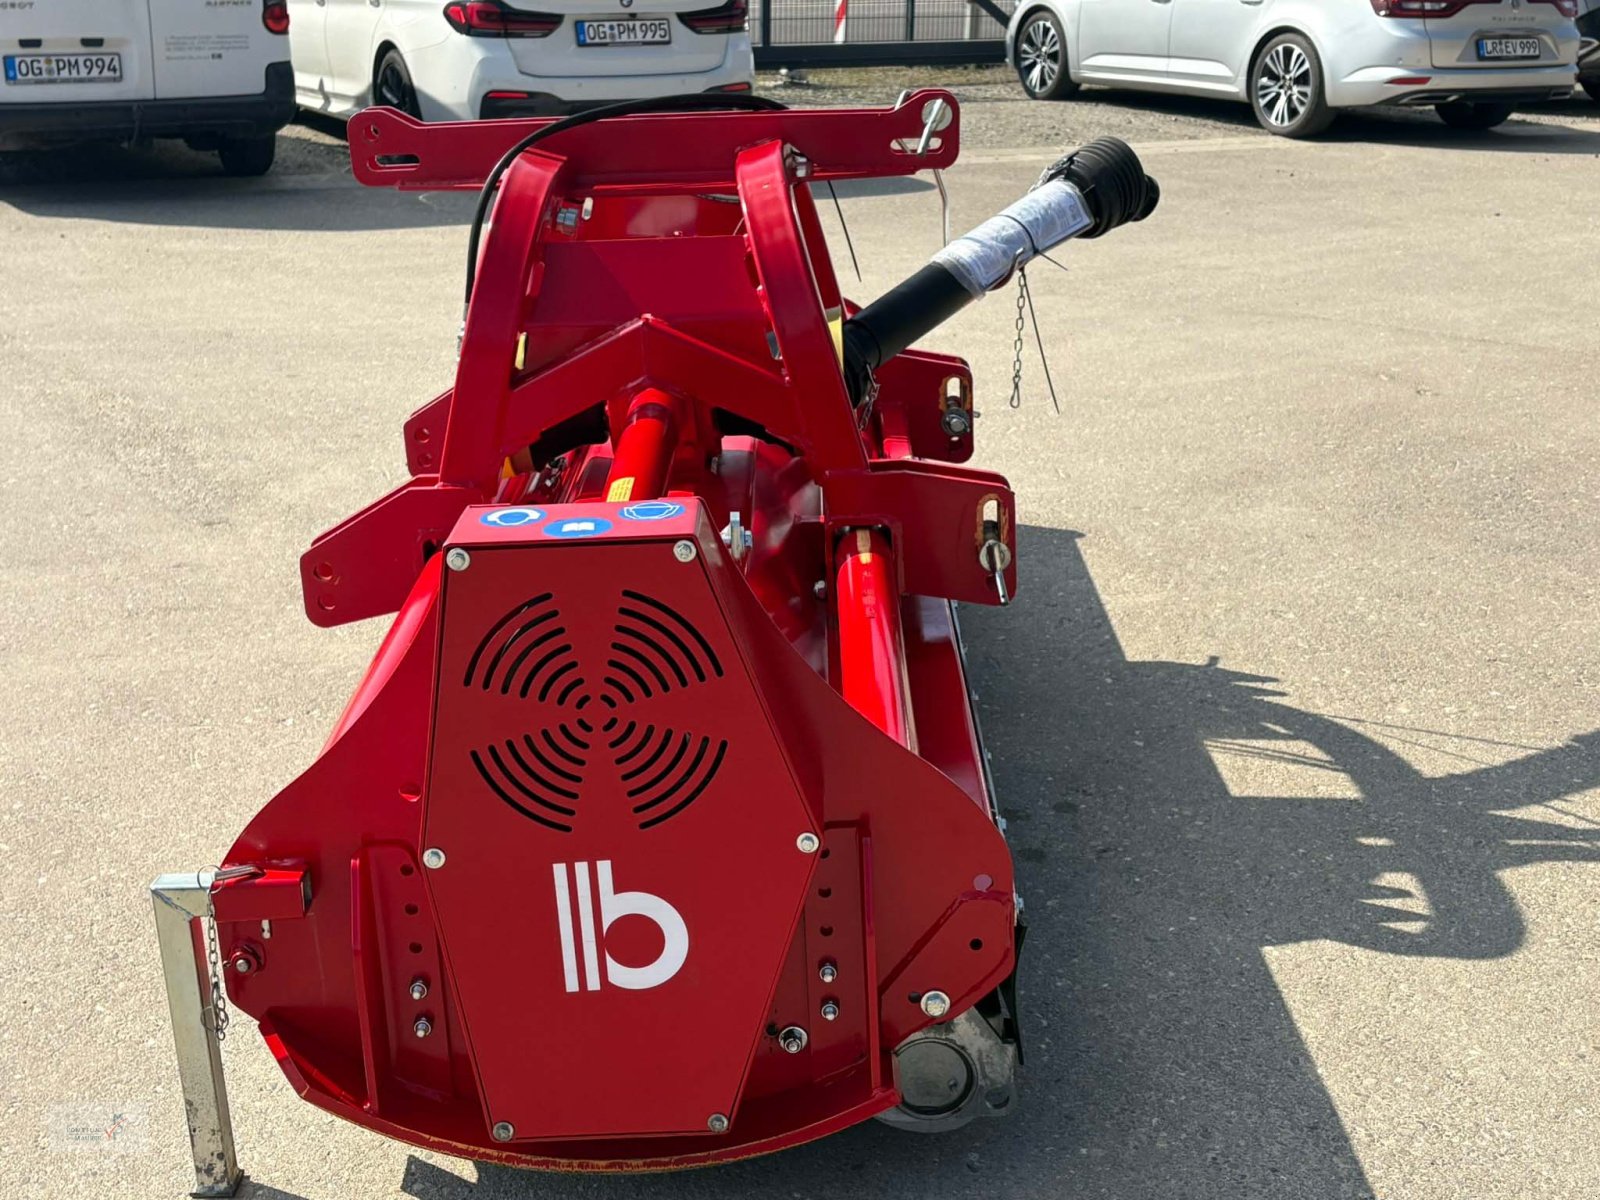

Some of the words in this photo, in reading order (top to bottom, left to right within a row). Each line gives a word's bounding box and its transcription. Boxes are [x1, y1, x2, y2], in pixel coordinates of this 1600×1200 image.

[587, 24, 607, 41] OG
[640, 22, 668, 39] 995
[18, 59, 43, 77] OG
[55, 58, 81, 76] PM
[83, 57, 118, 75] 994
